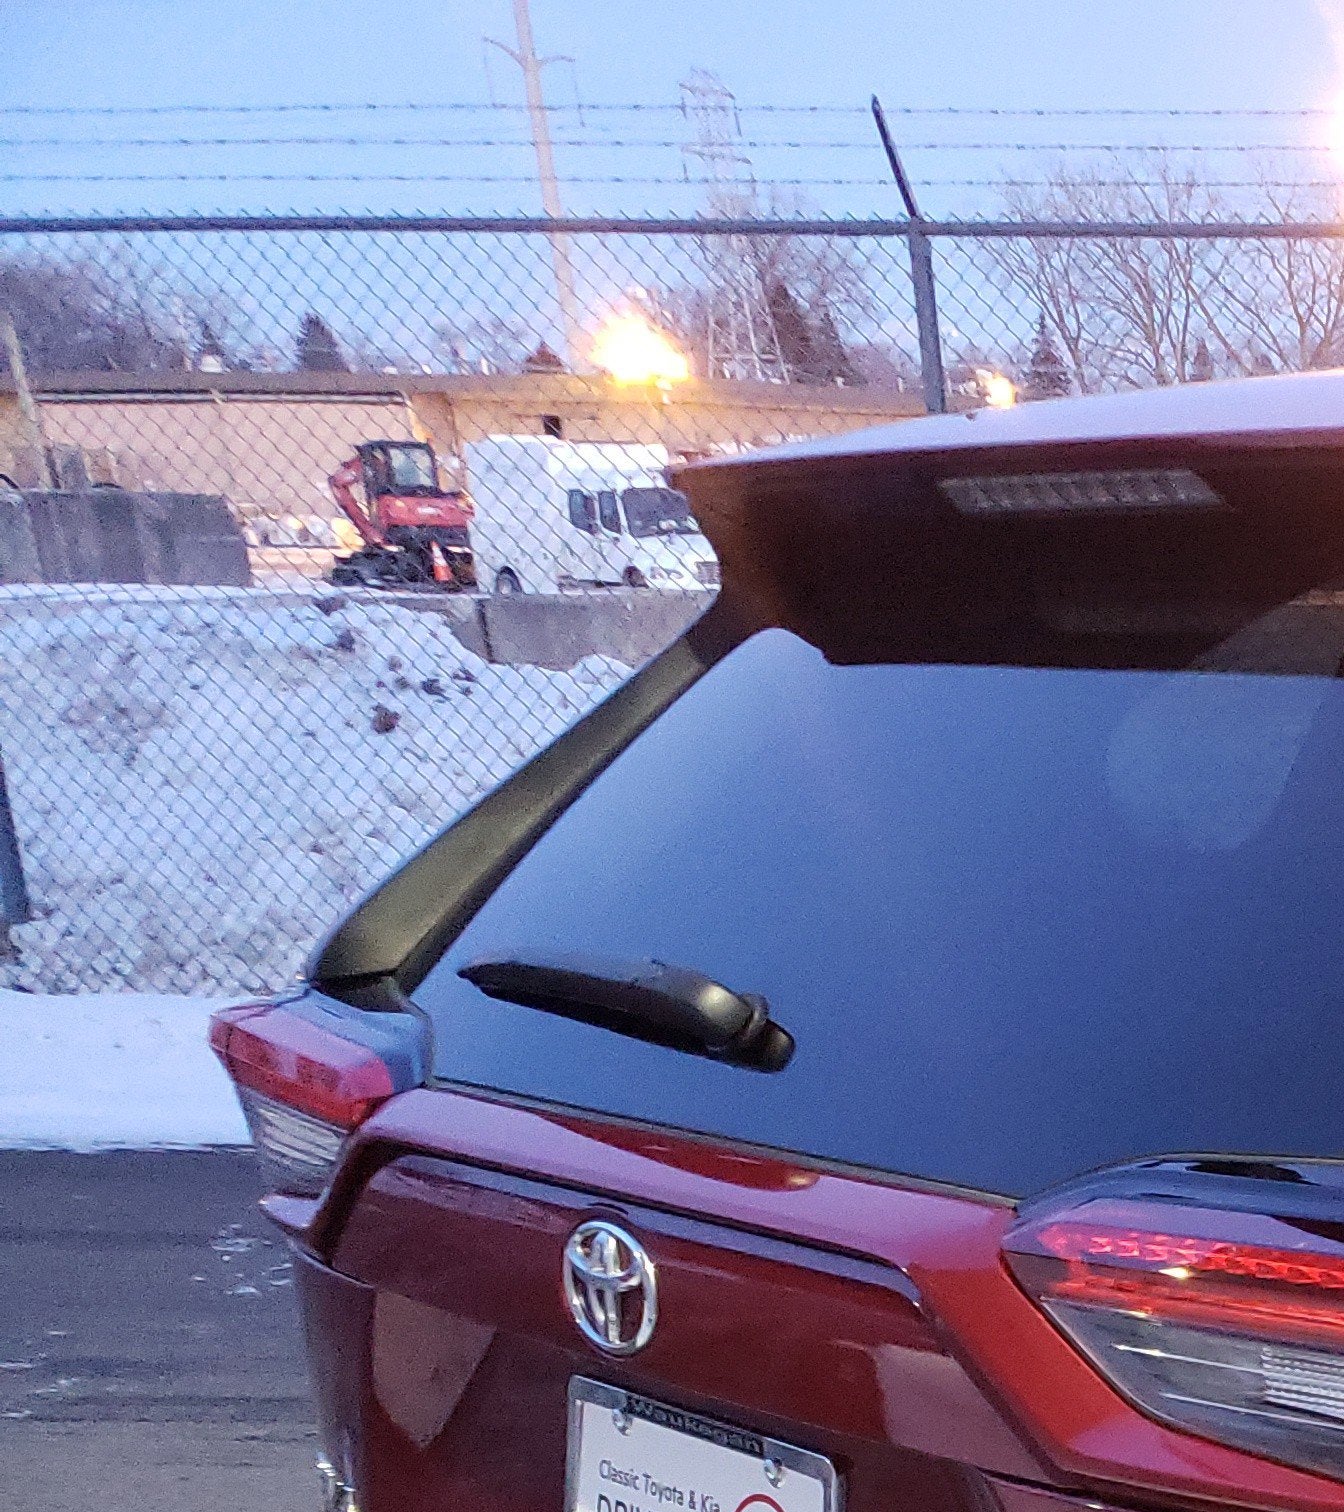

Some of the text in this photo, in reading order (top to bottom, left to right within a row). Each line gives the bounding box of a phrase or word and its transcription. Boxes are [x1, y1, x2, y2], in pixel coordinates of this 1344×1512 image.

[599, 1459, 640, 1491] Classic
[642, 1472, 685, 1507] Toyota
[688, 1489, 697, 1511] &
